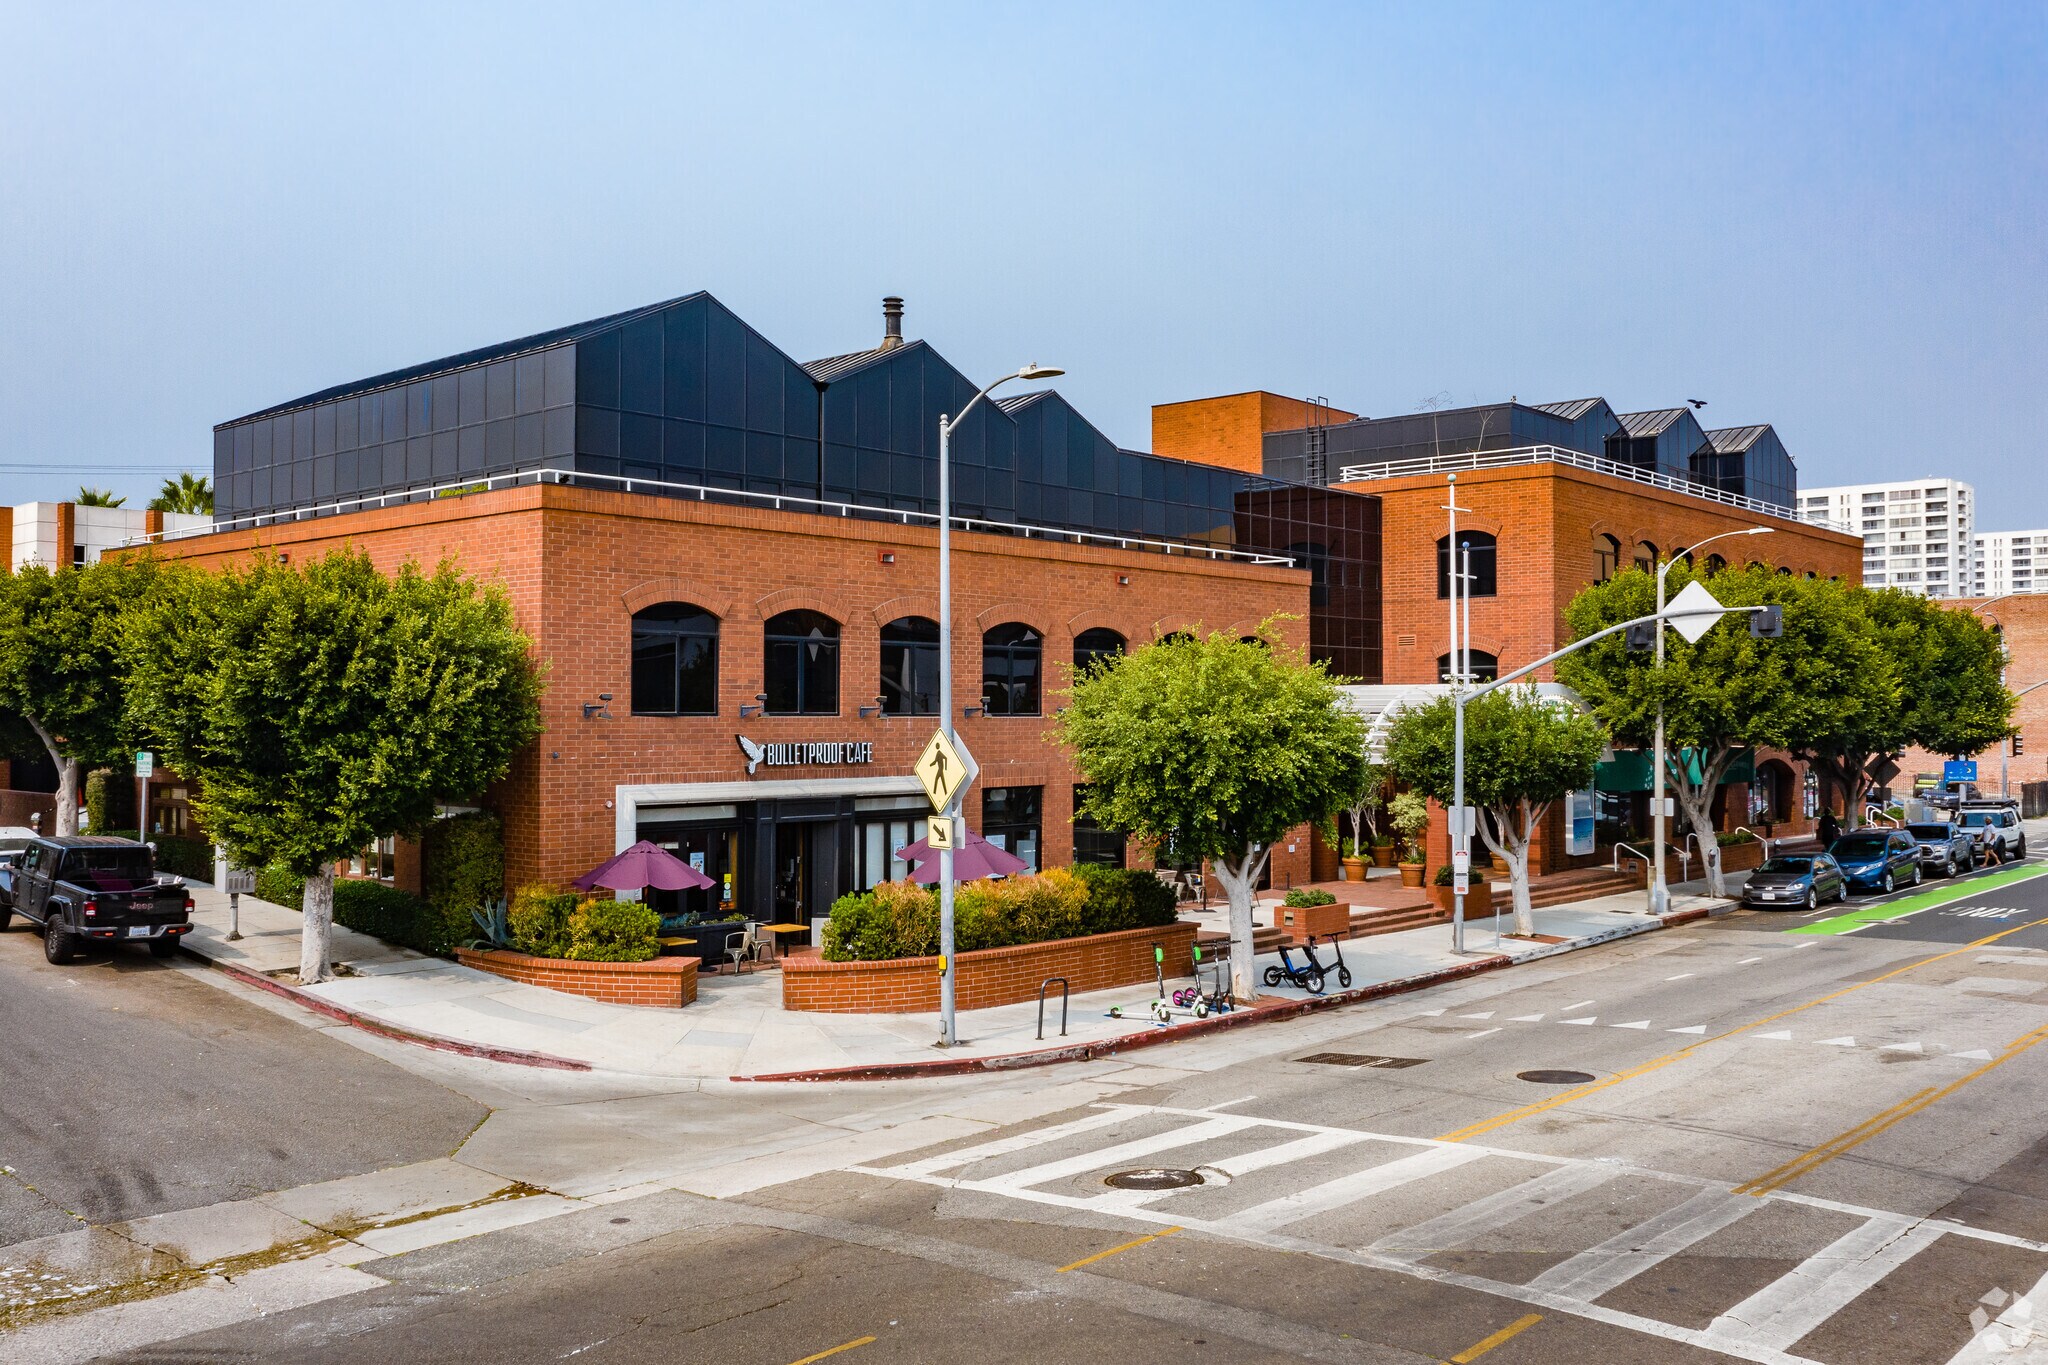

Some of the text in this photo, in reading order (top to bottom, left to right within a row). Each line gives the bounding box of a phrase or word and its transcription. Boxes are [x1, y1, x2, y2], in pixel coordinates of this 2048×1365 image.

[767, 742, 873, 766] BULLETPROOF CAFE
[129, 901, 154, 911] Jeep
